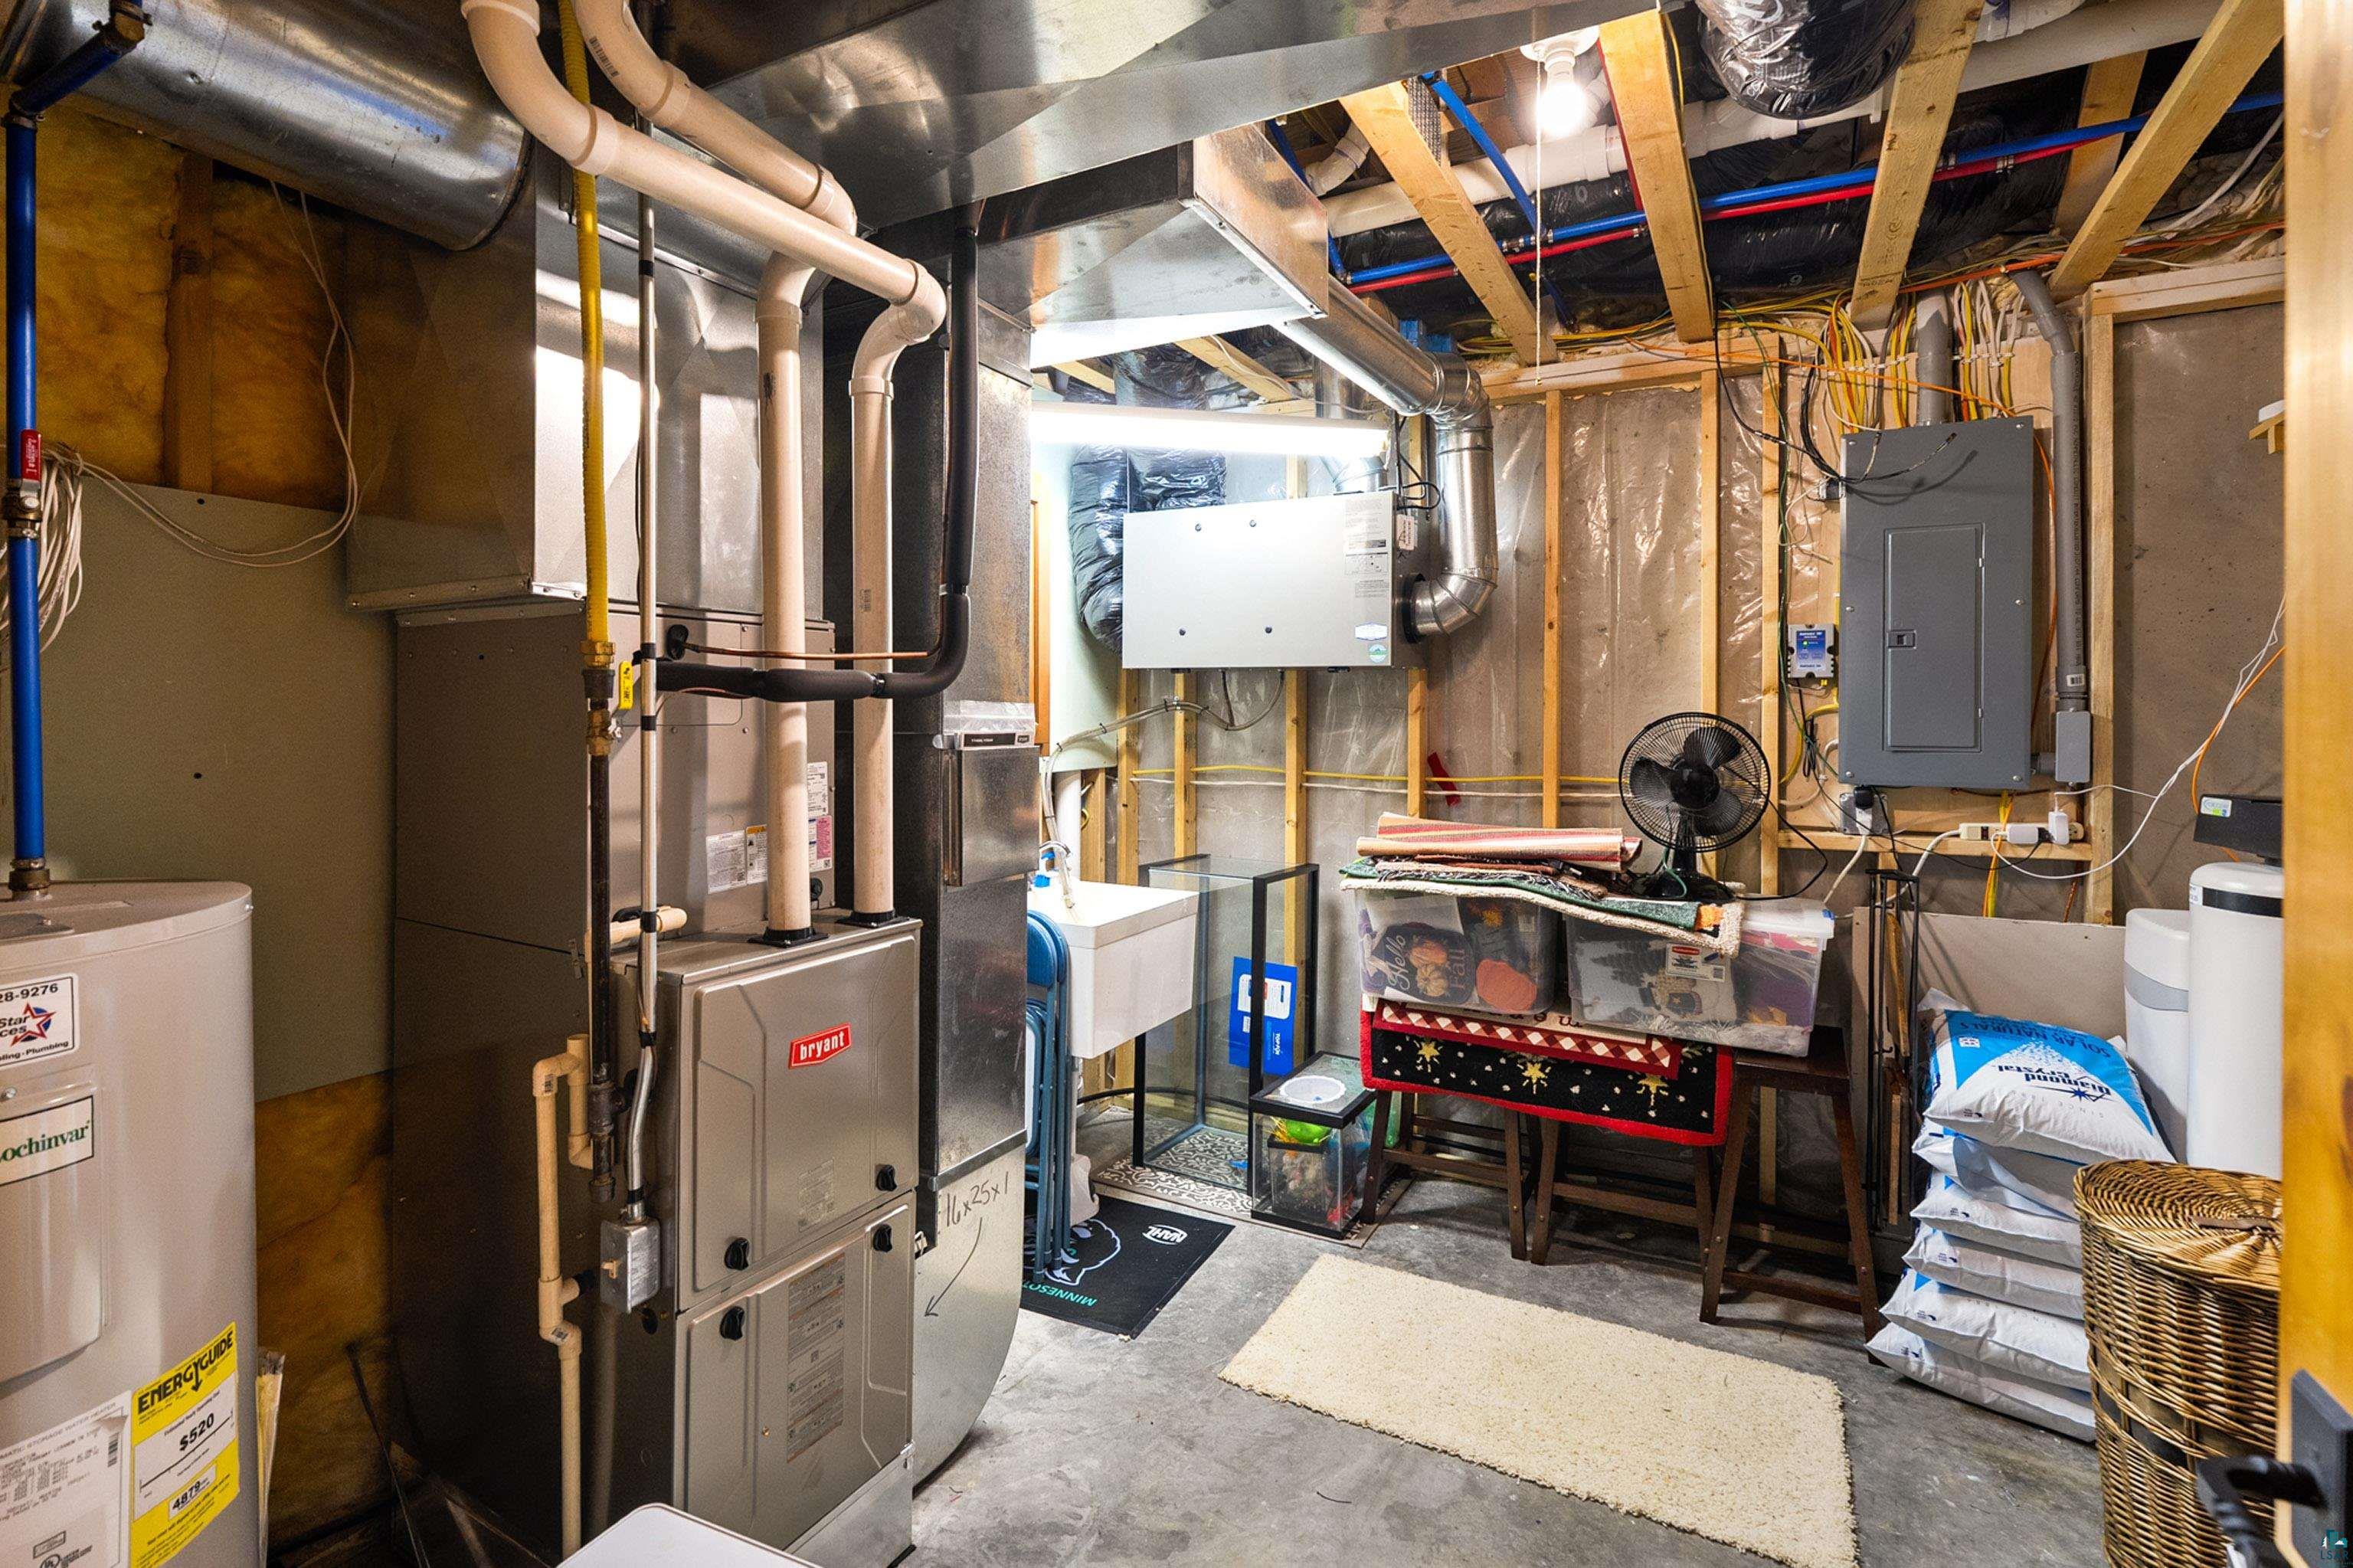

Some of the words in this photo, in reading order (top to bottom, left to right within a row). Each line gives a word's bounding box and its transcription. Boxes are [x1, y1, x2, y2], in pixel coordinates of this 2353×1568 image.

[1385, 935, 1411, 990] Hello
[800, 1030, 845, 1060] bryant
[1960, 1021, 2047, 1041] NATURALS
[2053, 1033, 2111, 1059] SOLAR
[26, 1041, 69, 1055] Plumbing
[1998, 1064, 2070, 1079] Crystal
[2024, 1073, 2112, 1096] Diamond
[0, 1124, 90, 1163] ochinvar
[946, 1170, 1009, 1227] 16x25x1
[1145, 1225, 1187, 1243] NAHL
[138, 1330, 233, 1415] ENERGYGUIDE
[179, 1413, 214, 1452] $520
[172, 1481, 201, 1511] 4879
